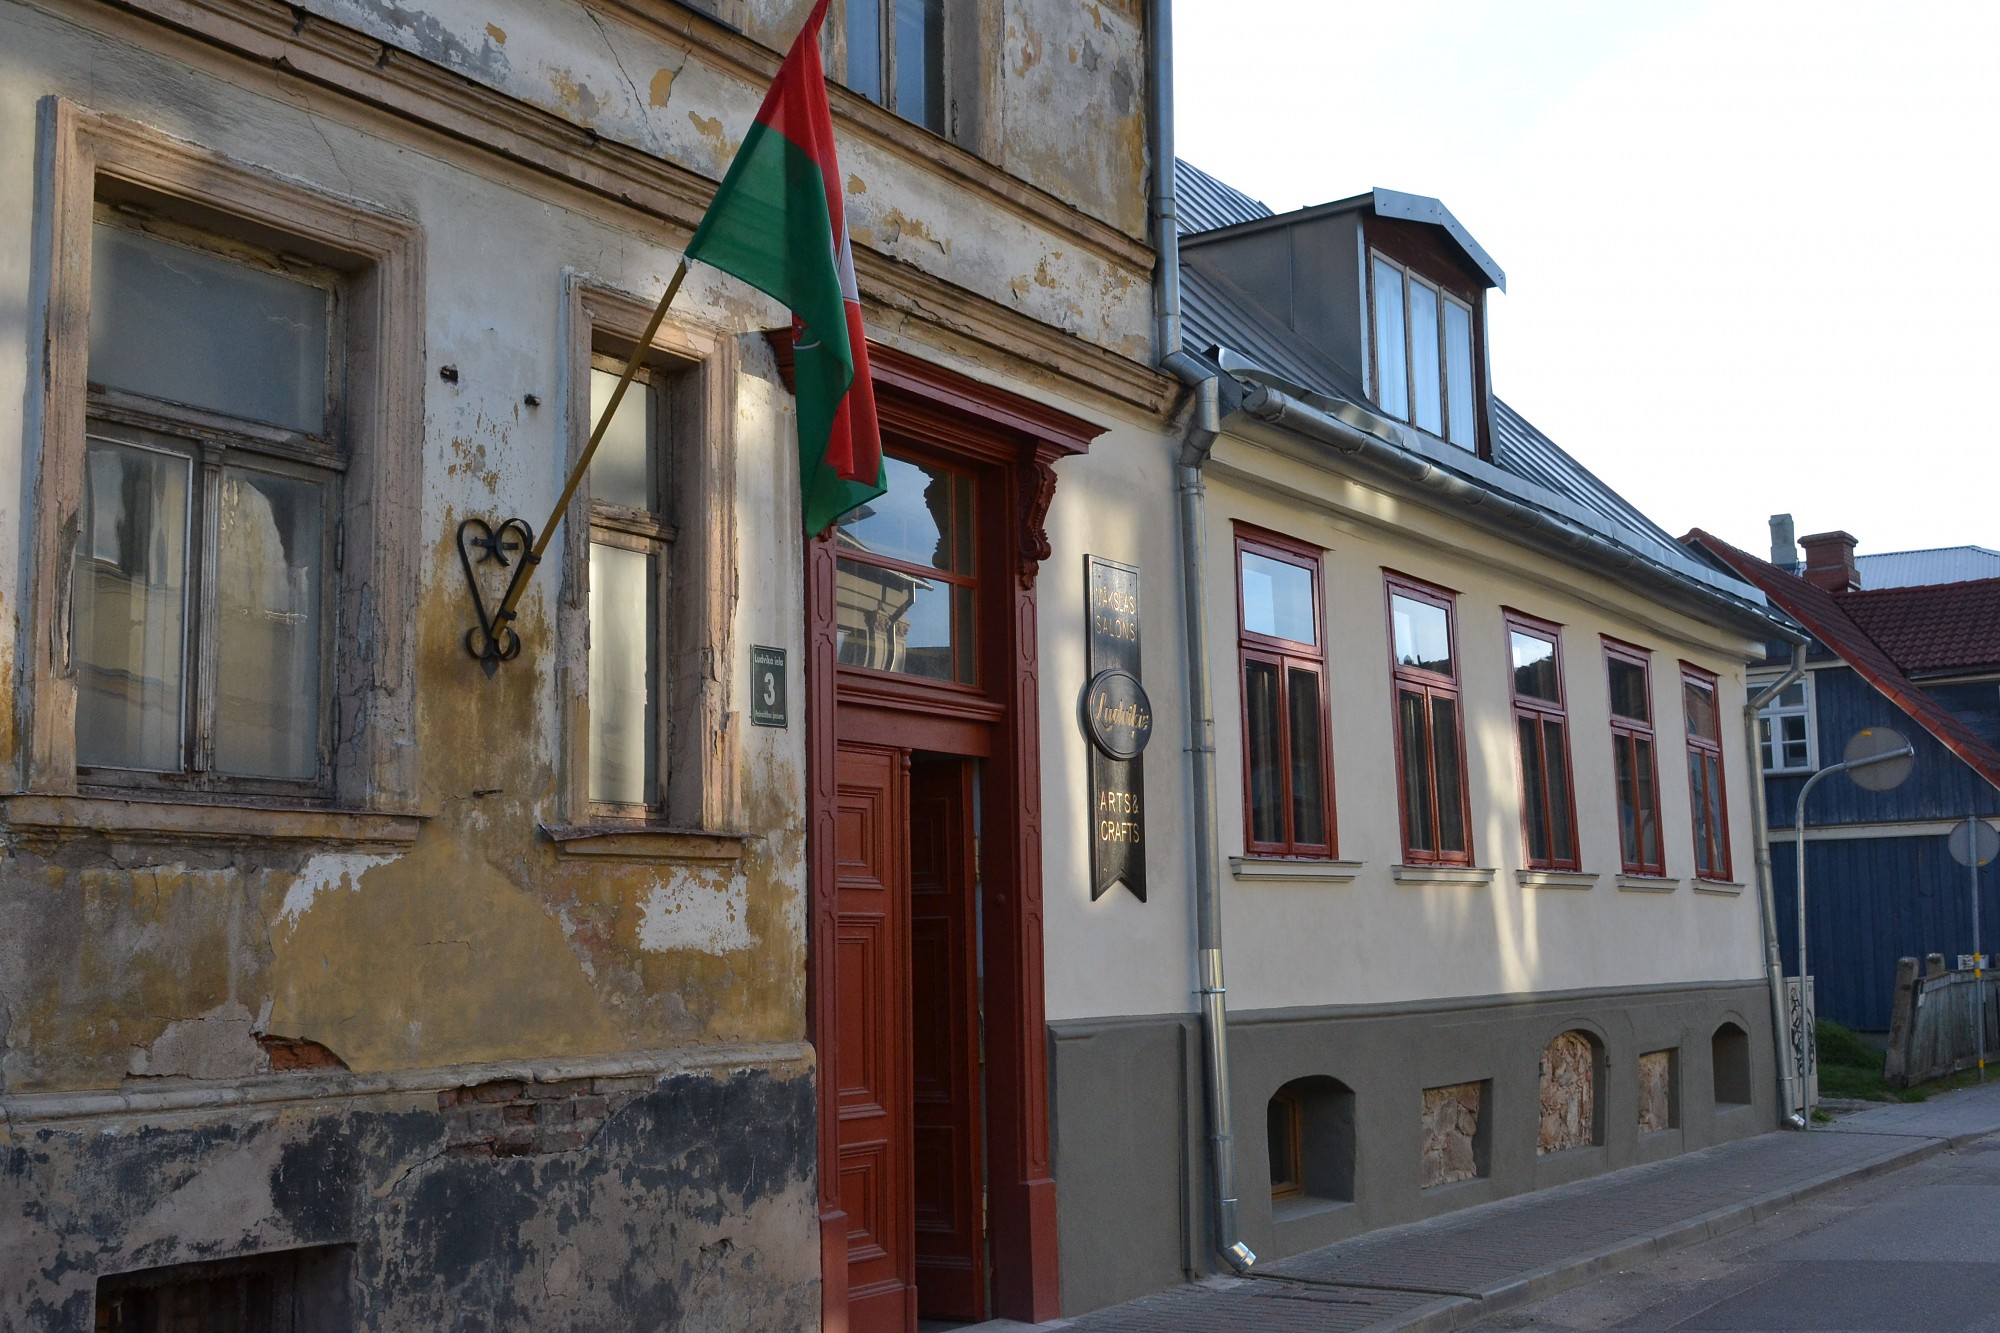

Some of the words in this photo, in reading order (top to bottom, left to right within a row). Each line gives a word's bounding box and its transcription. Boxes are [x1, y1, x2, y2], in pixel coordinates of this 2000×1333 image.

[1096, 615, 1135, 641] SALONS
[774, 655, 784, 666] iela
[763, 672, 775, 706] 3
[1101, 820, 1140, 843] CRAFTS
